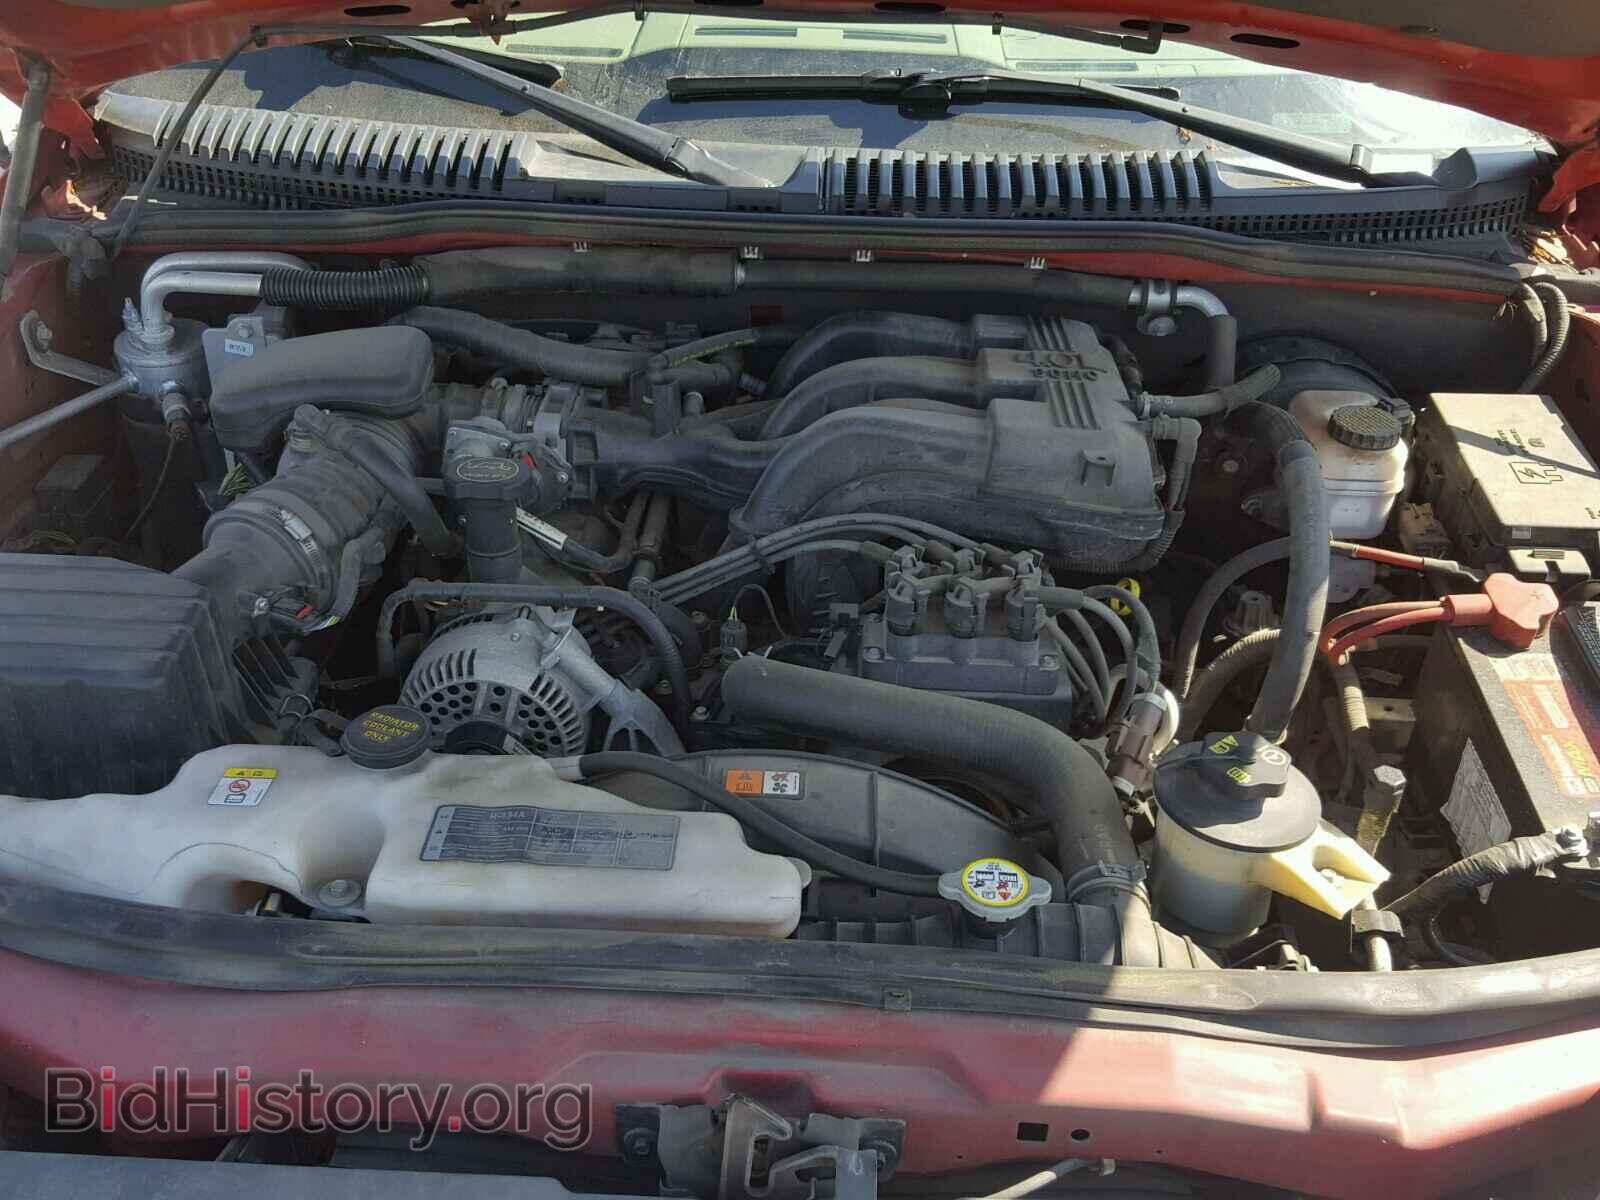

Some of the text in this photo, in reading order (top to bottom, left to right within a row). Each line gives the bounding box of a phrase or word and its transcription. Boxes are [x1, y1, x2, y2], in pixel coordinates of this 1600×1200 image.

[363, 719, 410, 737] COOLANT
[369, 711, 419, 731] RADIATOR
[364, 730, 393, 743] ONLY
